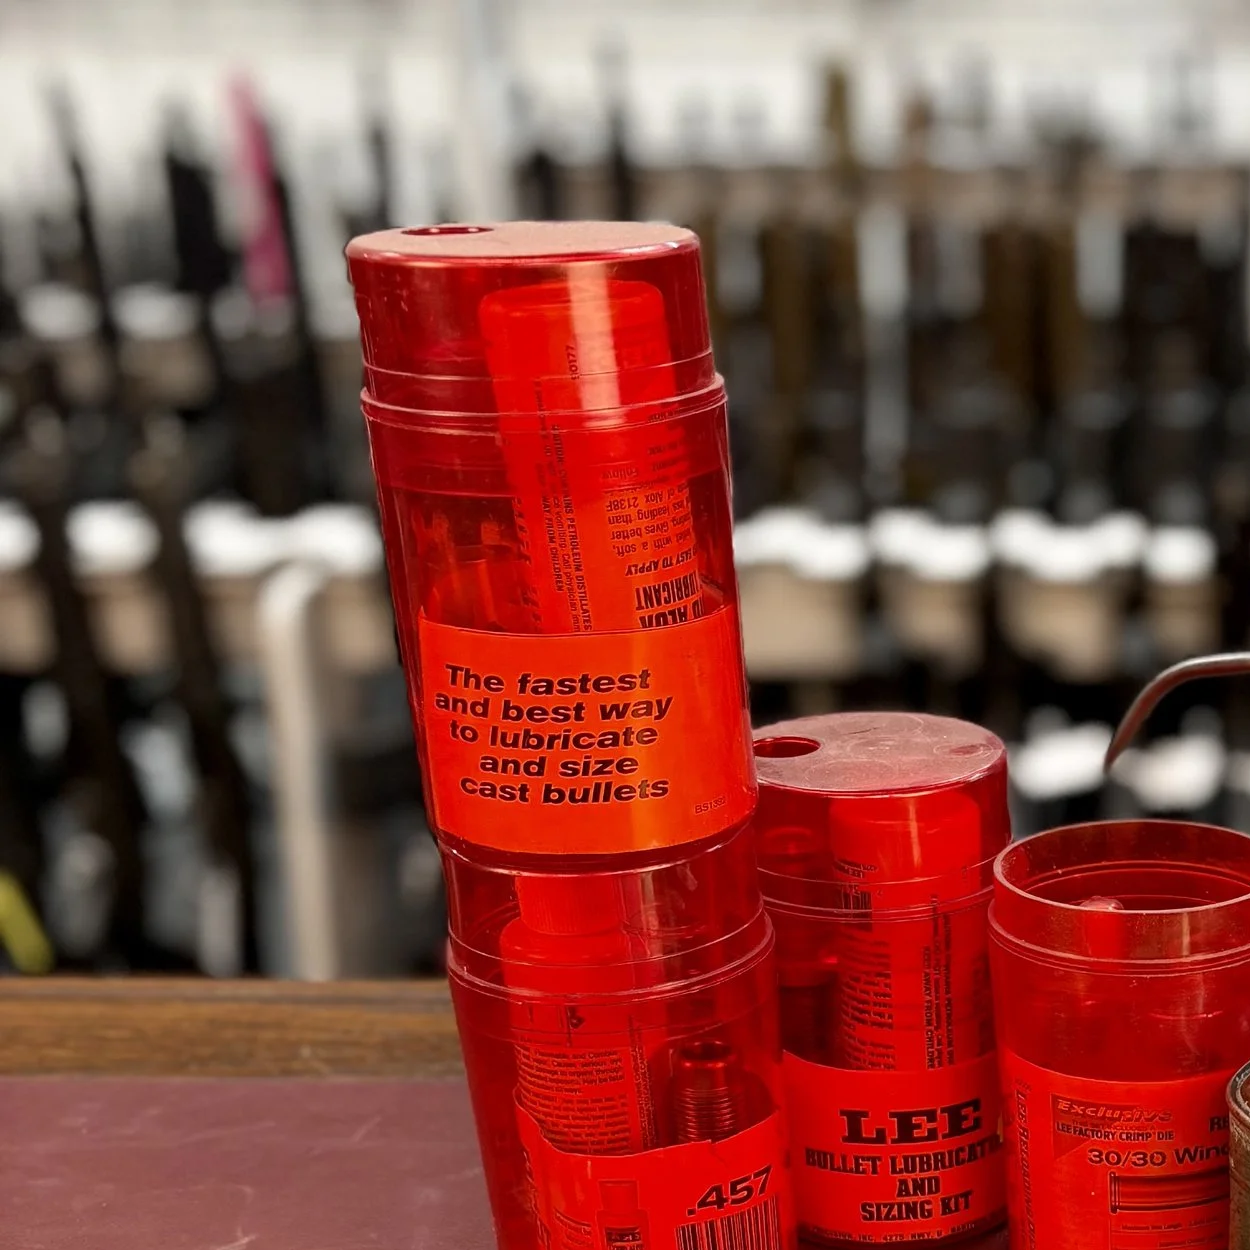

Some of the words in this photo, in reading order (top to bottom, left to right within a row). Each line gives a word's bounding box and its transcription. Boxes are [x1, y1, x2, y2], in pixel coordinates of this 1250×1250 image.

[608, 512, 633, 525] than
[637, 505, 671, 522] leading
[610, 526, 642, 540] better
[612, 544, 637, 558] soft,
[566, 515, 583, 572] PETROLEUM
[575, 575, 593, 632] DISTILLATES
[625, 560, 659, 576] APPLY
[445, 664, 504, 692] The
[518, 668, 651, 696] fastest
[434, 692, 490, 718] and
[501, 699, 585, 723] best
[599, 696, 673, 721] way
[450, 719, 479, 743] to
[489, 725, 659, 750] lubricate
[480, 754, 547, 777] and
[558, 754, 639, 777] size
[460, 777, 530, 803] cast
[542, 778, 670, 804] bullets
[839, 1098, 981, 1144] LEE
[1057, 1099, 1173, 1122] Exclusive
[1056, 1122, 1072, 1134] LEE
[1073, 1127, 1116, 1140] FACTORY
[1119, 1130, 1152, 1141] CRIMP
[1157, 1131, 1174, 1140] DIE
[805, 1147, 882, 1175] BULLET
[1087, 1149, 1167, 1167] 30/30
[686, 1164, 773, 1217] .457
[896, 1176, 940, 1197] AND
[860, 1200, 933, 1221] SIZING
[940, 1190, 973, 1216] KIT
